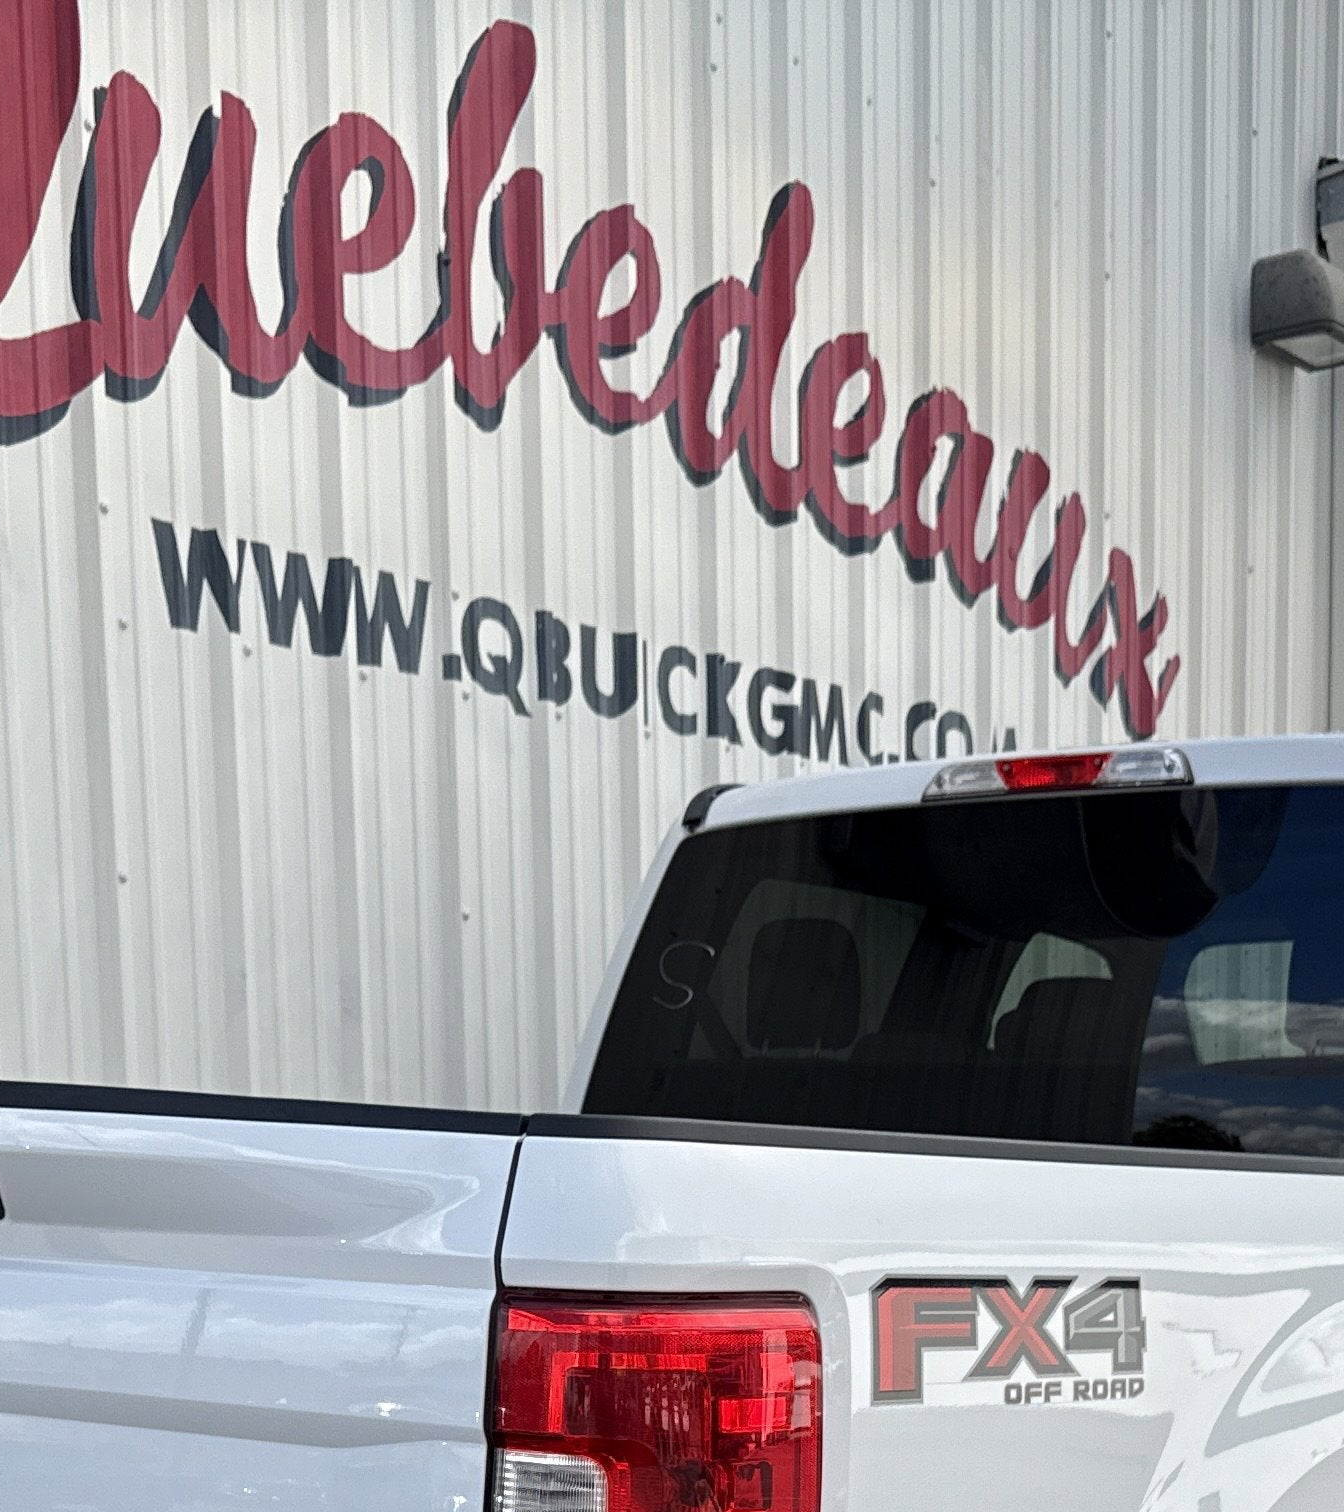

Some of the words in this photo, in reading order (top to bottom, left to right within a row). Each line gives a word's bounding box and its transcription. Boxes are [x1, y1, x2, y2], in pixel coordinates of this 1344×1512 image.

[151, 517, 1016, 758] WWW.QBUICKGMC.CO
[870, 1275, 1147, 1406] FX4
[1004, 1382, 1062, 1405] OFF
[1073, 1378, 1145, 1401] ROAD
